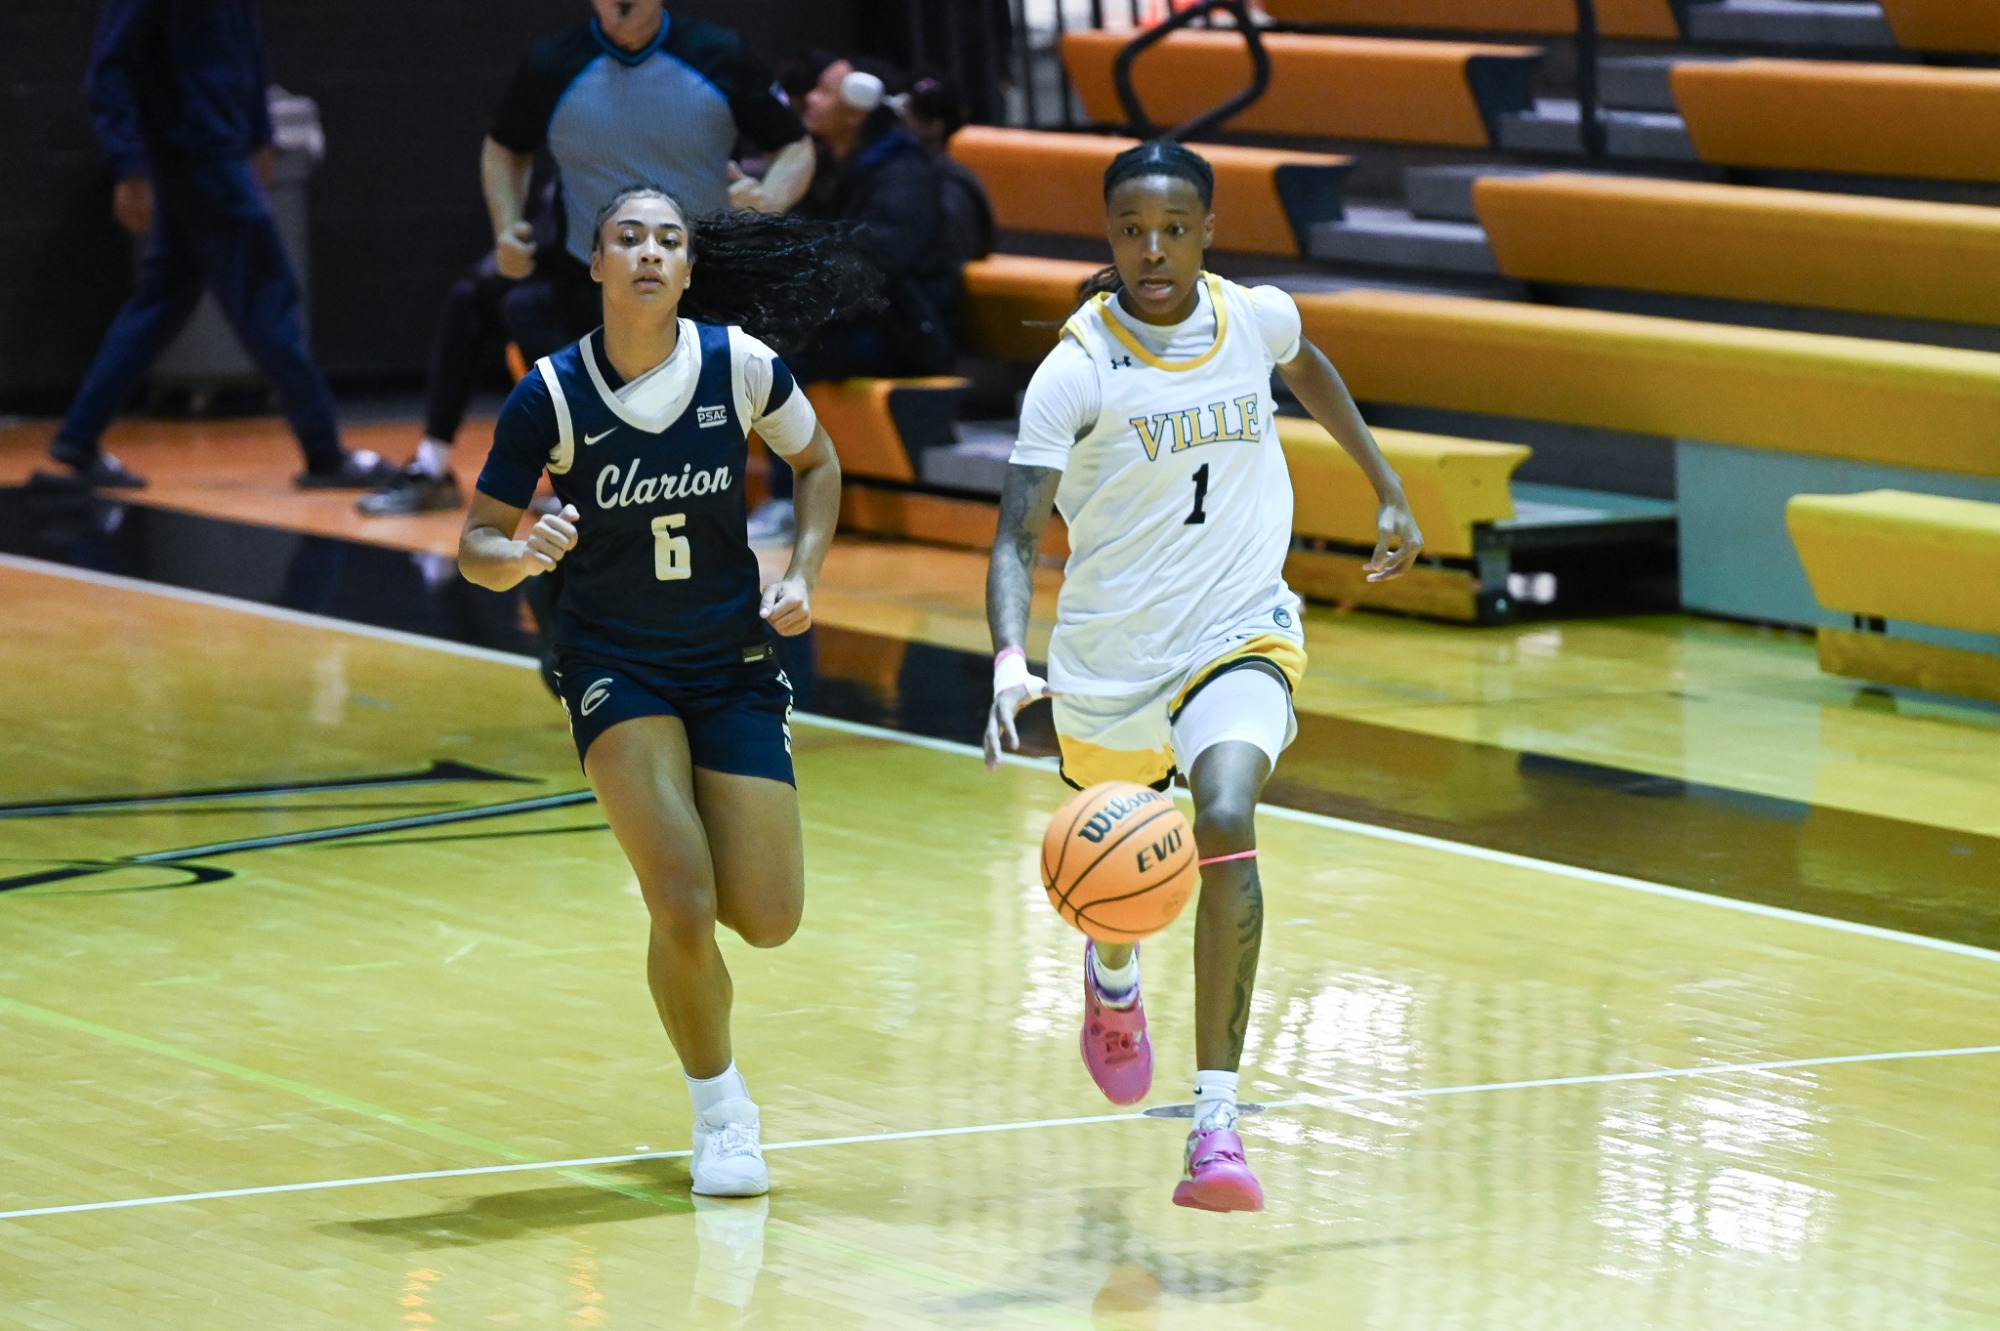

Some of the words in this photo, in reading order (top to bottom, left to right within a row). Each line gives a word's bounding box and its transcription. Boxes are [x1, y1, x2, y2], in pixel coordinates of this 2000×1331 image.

[697, 409, 728, 423] PSAC
[1129, 392, 1262, 462] VILLE
[596, 458, 732, 509] Clarion
[1183, 463, 1209, 525] 1
[651, 513, 692, 581] 6
[1077, 790, 1164, 843] Wilson
